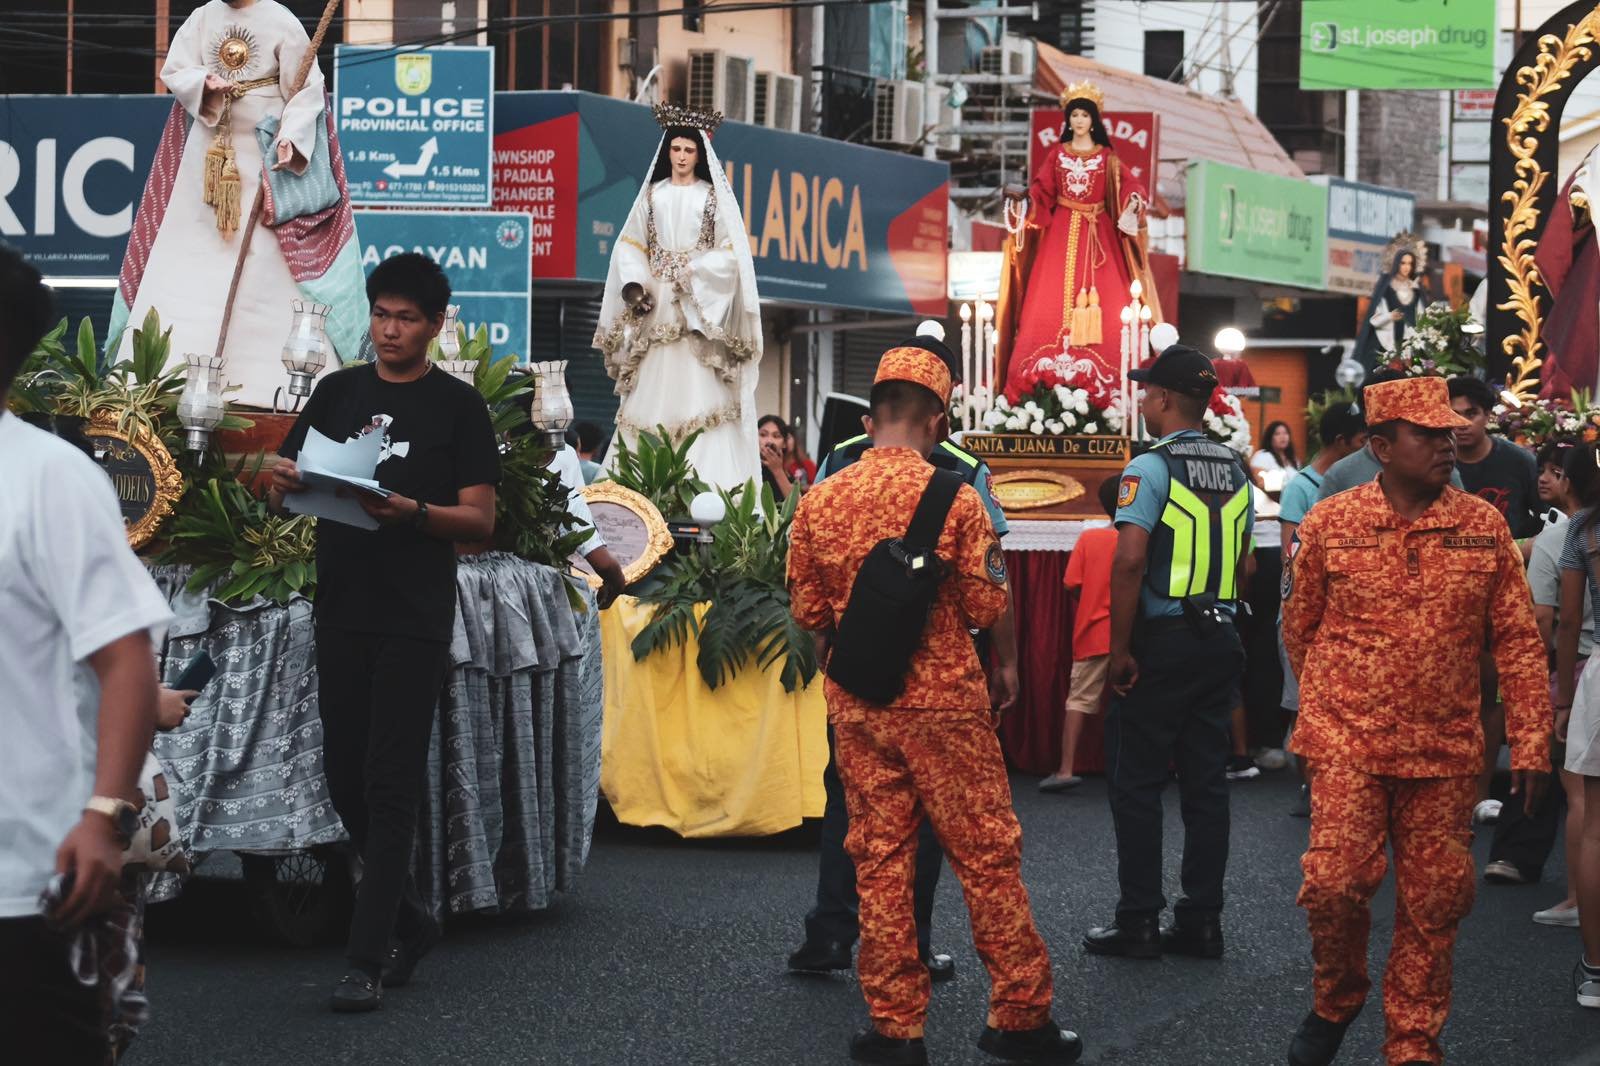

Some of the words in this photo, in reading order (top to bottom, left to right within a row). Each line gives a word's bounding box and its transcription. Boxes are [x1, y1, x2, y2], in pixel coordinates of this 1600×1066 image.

[342, 97, 485, 118] POLICE
[341, 118, 429, 132] PROVINCIAL
[432, 119, 485, 132] OFFICE
[369, 151, 396, 162] Kms
[452, 166, 480, 177] Kms
[503, 168, 555, 183] PADALA
[493, 186, 556, 202] CHANGER
[725, 160, 868, 271] LARICA
[965, 437, 1005, 452] SANTA
[1009, 438, 1055, 453] JUANA
[1063, 439, 1081, 454] De
[1088, 439, 1125, 454] CUZA
[1185, 459, 1234, 491] POLICE
[1337, 538, 1366, 546] GARCIA
